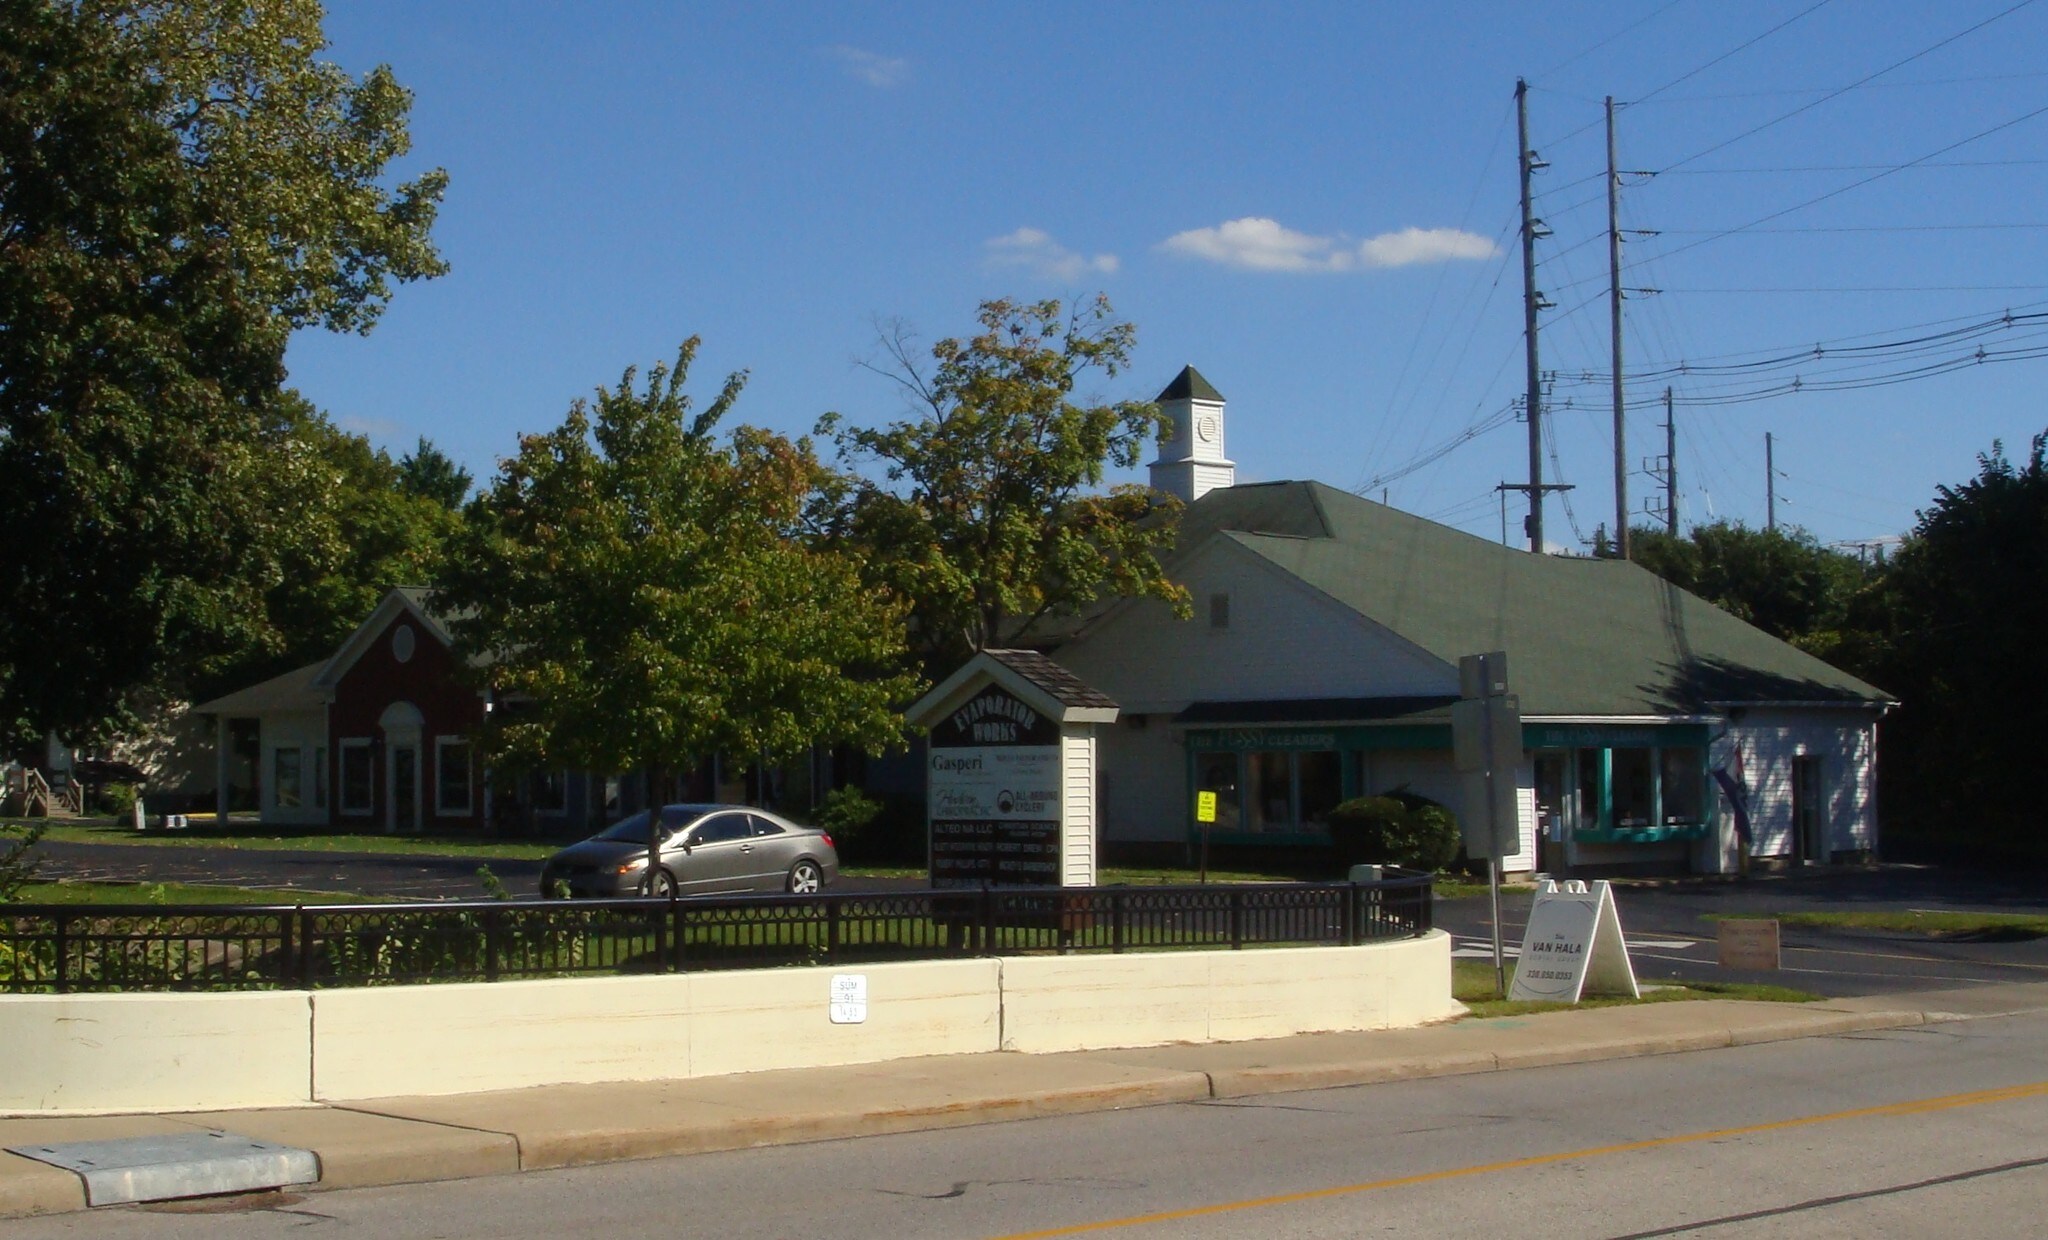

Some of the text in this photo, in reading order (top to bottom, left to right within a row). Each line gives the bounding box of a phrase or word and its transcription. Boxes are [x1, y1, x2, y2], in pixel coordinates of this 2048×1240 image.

[953, 695, 1036, 733] EVAPORATOR
[973, 722, 1017, 742] WORKS
[933, 755, 983, 775] Gasperi
[1532, 942, 1582, 954] VAN HALA
